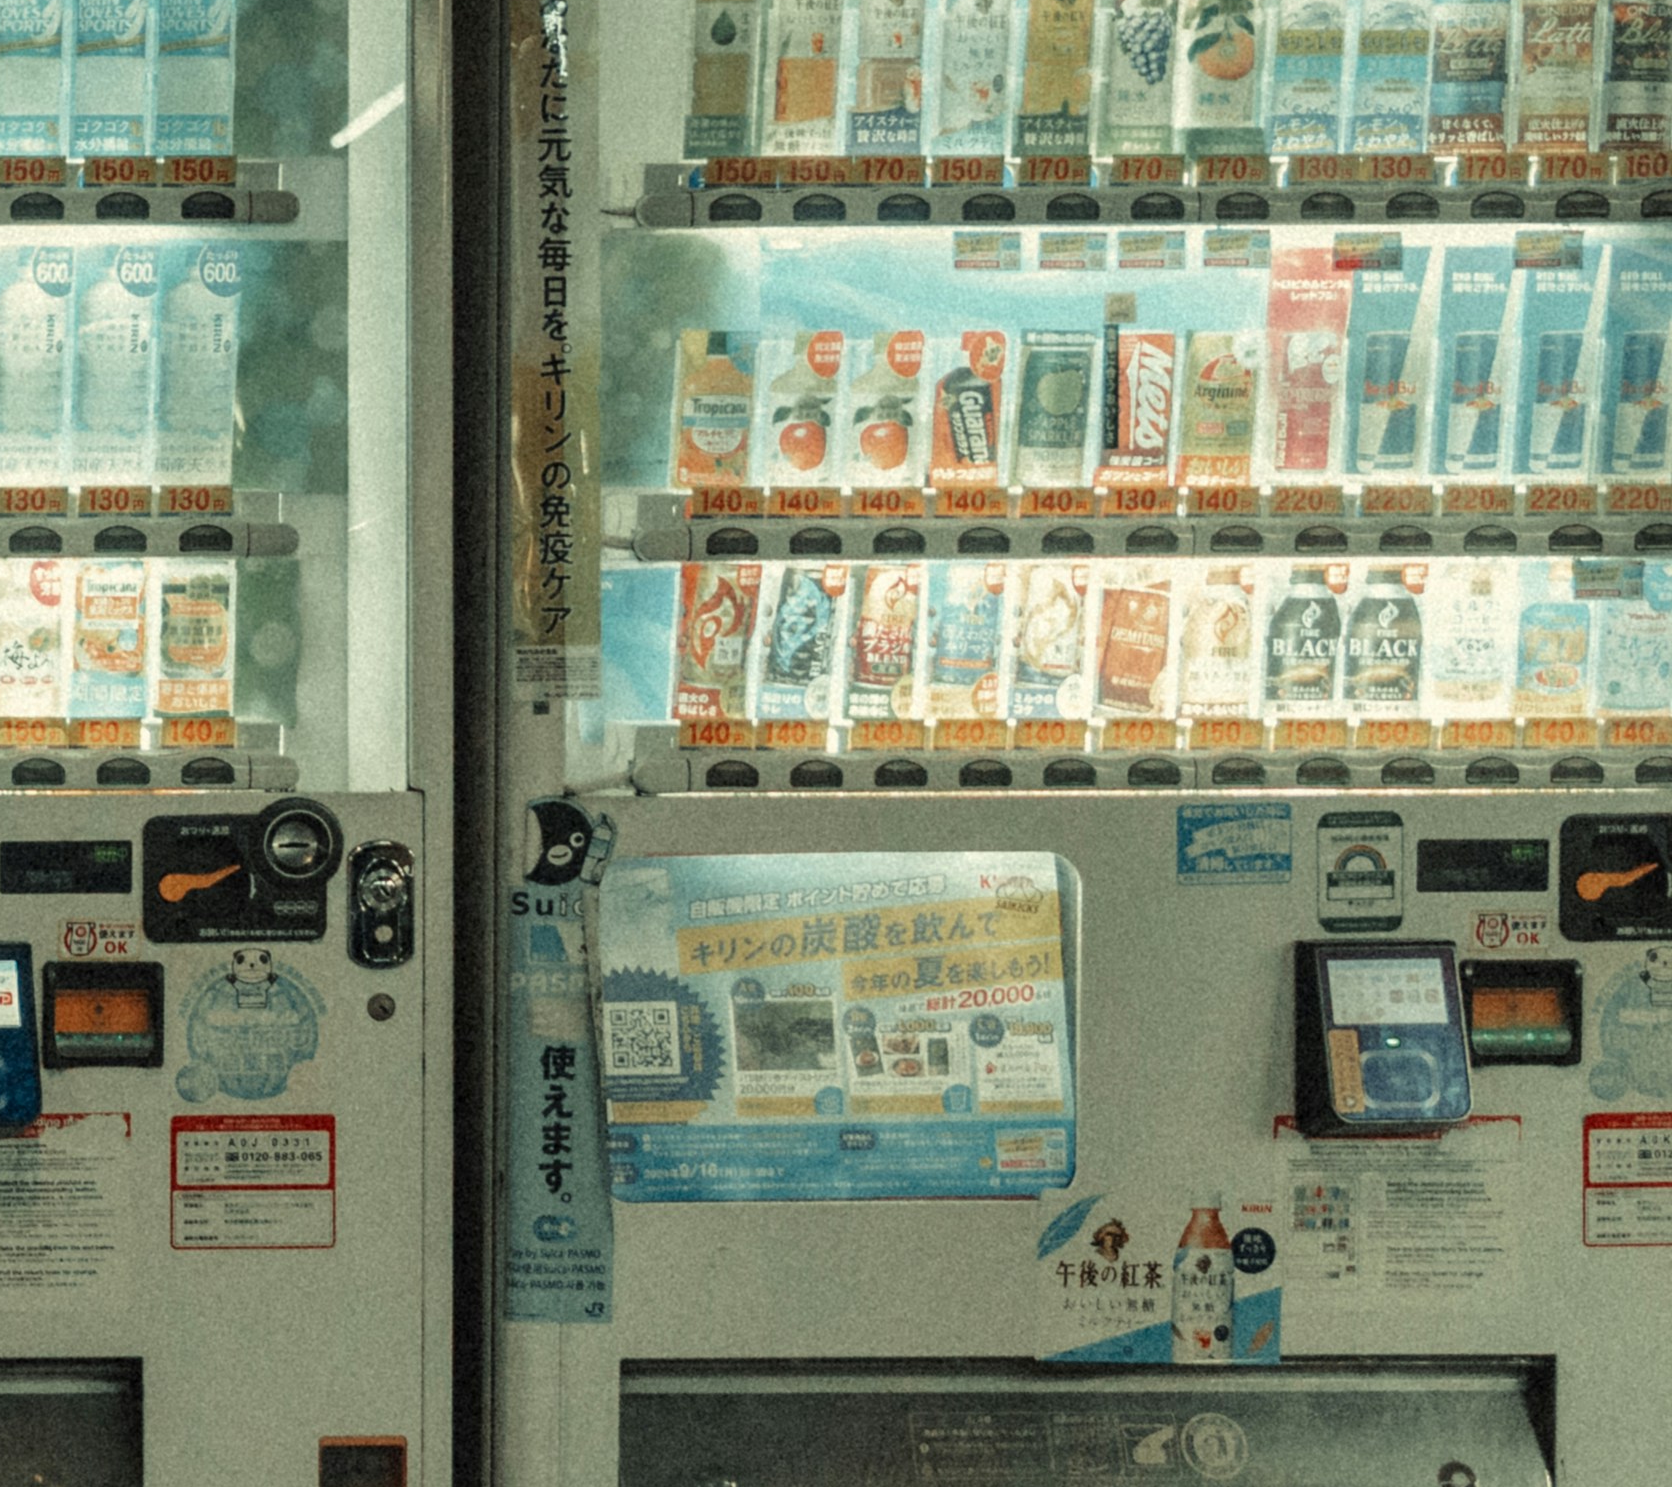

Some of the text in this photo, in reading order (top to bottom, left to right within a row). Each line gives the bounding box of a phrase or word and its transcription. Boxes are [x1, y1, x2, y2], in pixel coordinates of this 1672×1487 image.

[689, 909, 999, 966] キリンの炭酸を飲んで
[1516, 932, 1541, 946] OK
[104, 940, 130, 956] OK
